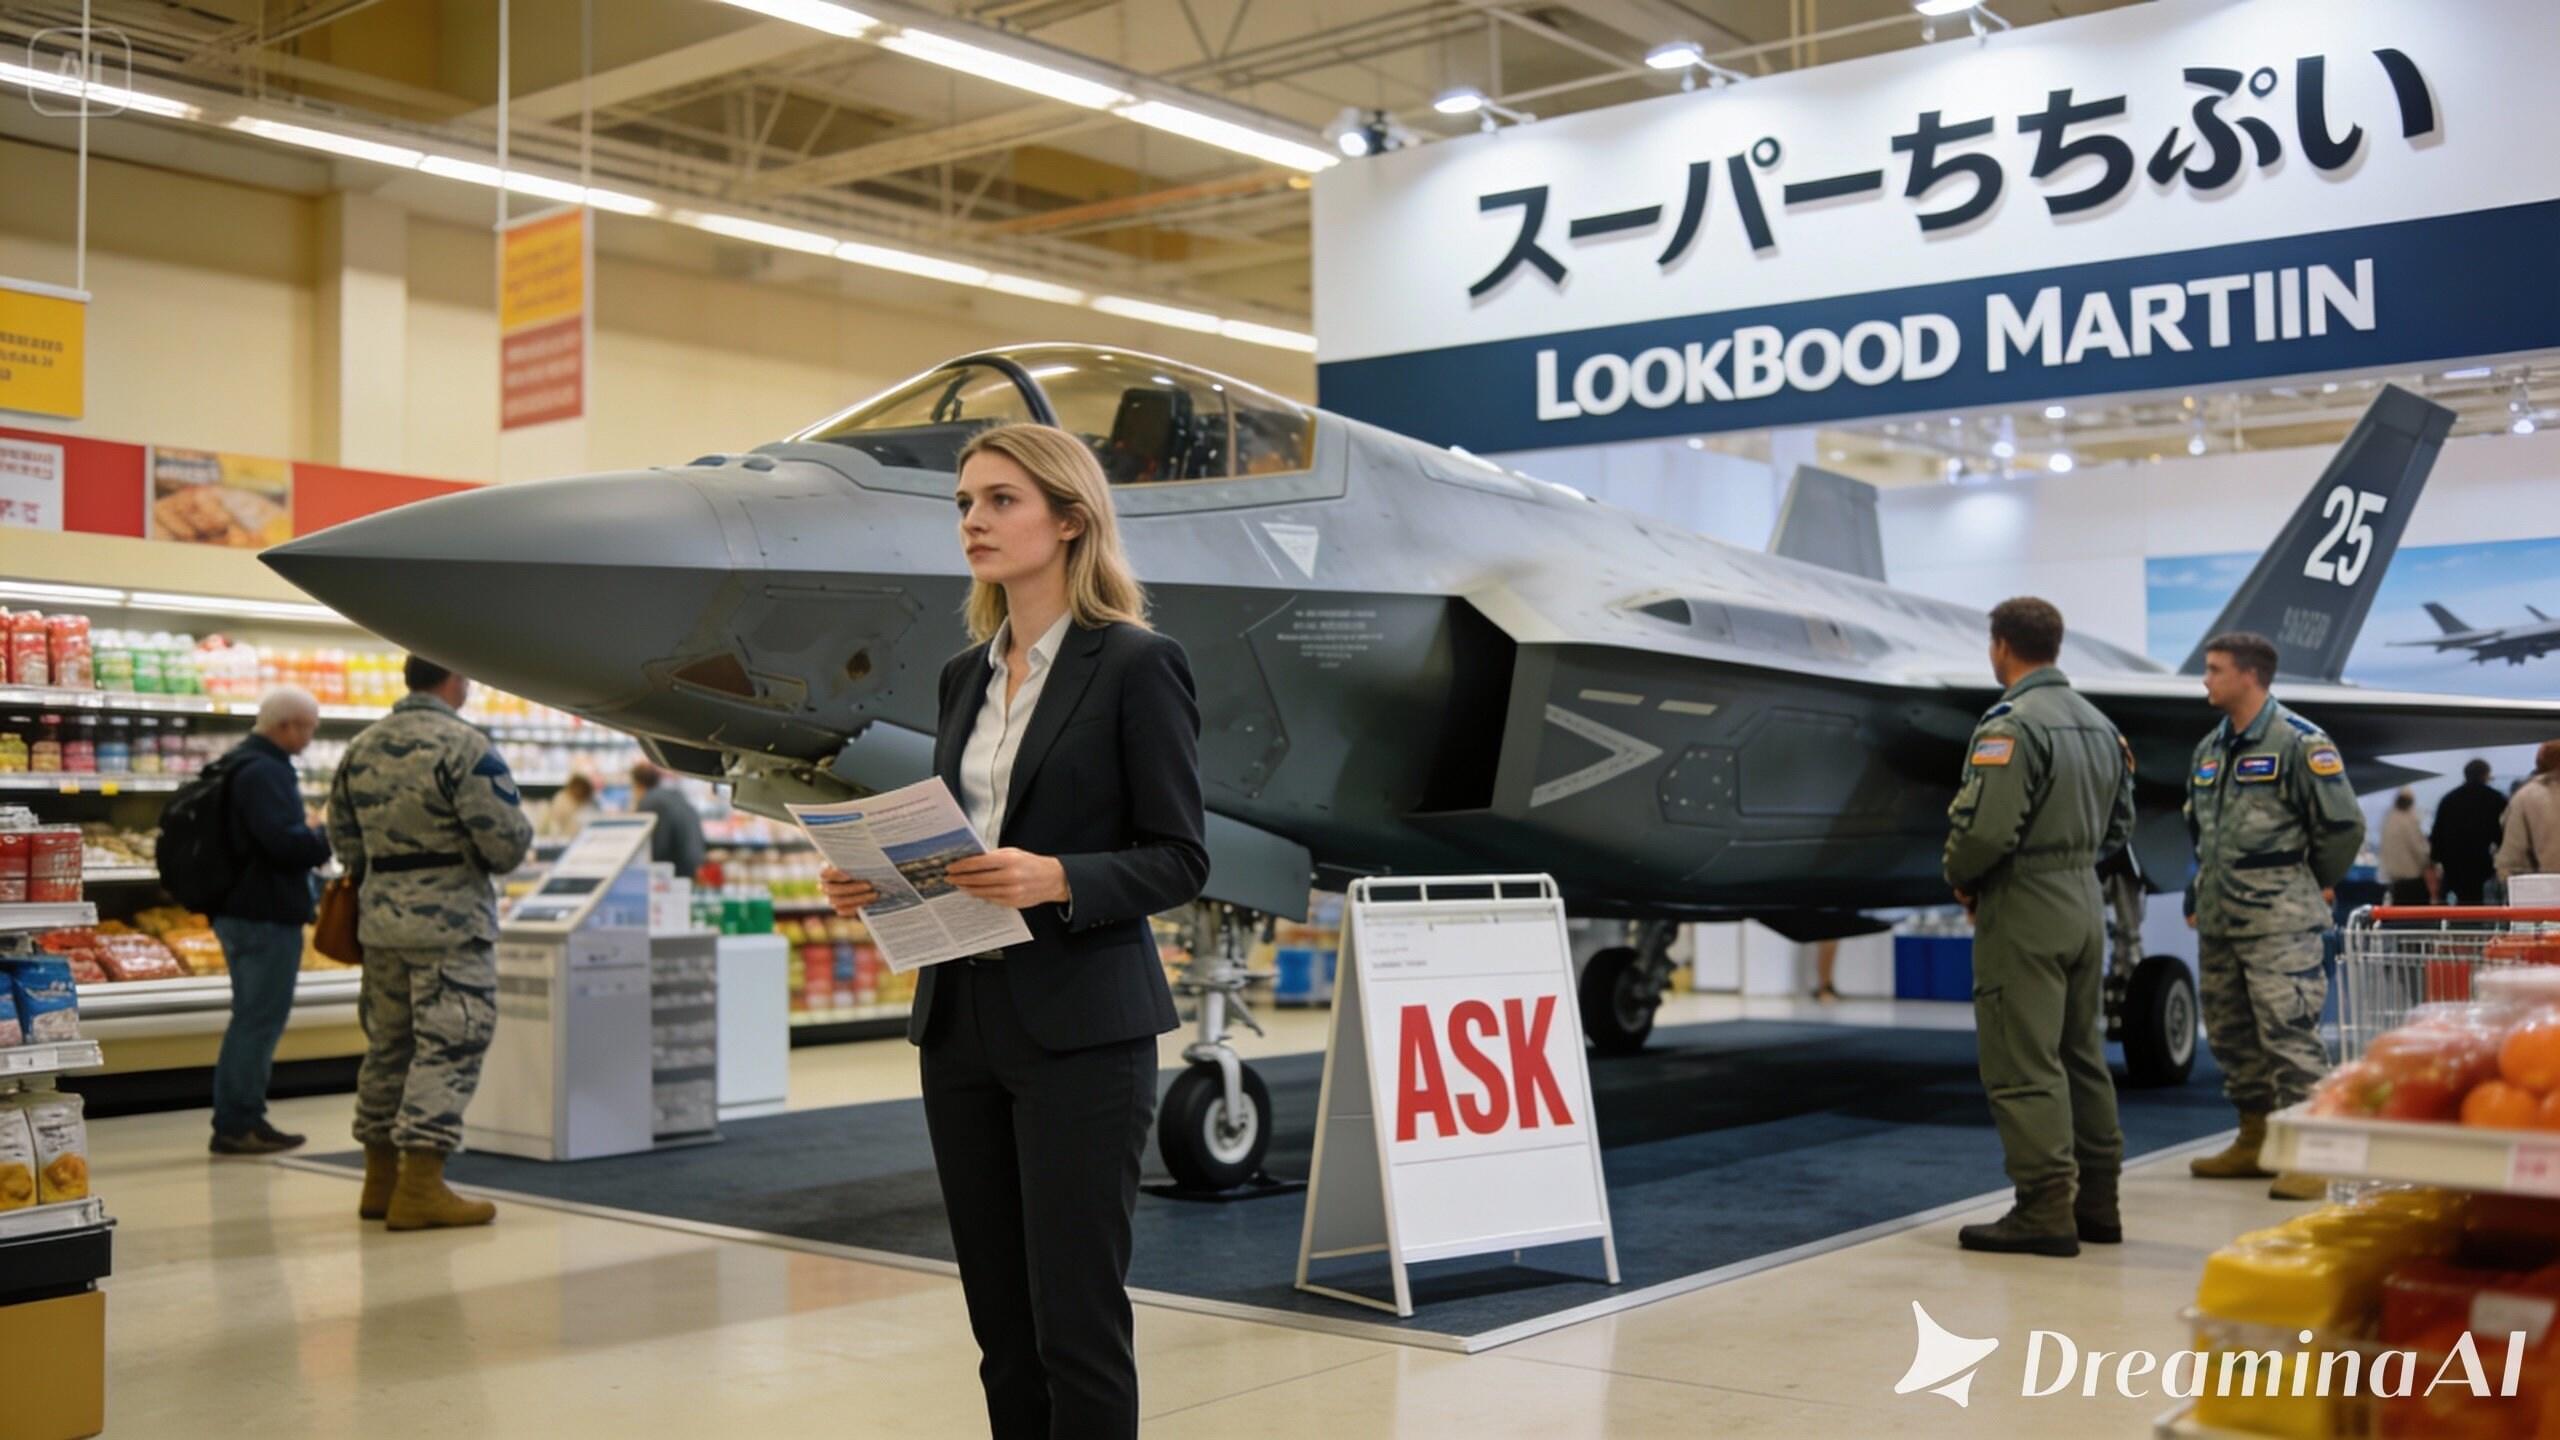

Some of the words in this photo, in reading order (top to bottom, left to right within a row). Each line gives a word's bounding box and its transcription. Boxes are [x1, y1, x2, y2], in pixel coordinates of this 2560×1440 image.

[1469, 46, 2436, 298] スーパーちちぷい
[2303, 484, 2388, 588] 25
[1395, 995, 1574, 1142] ASK
